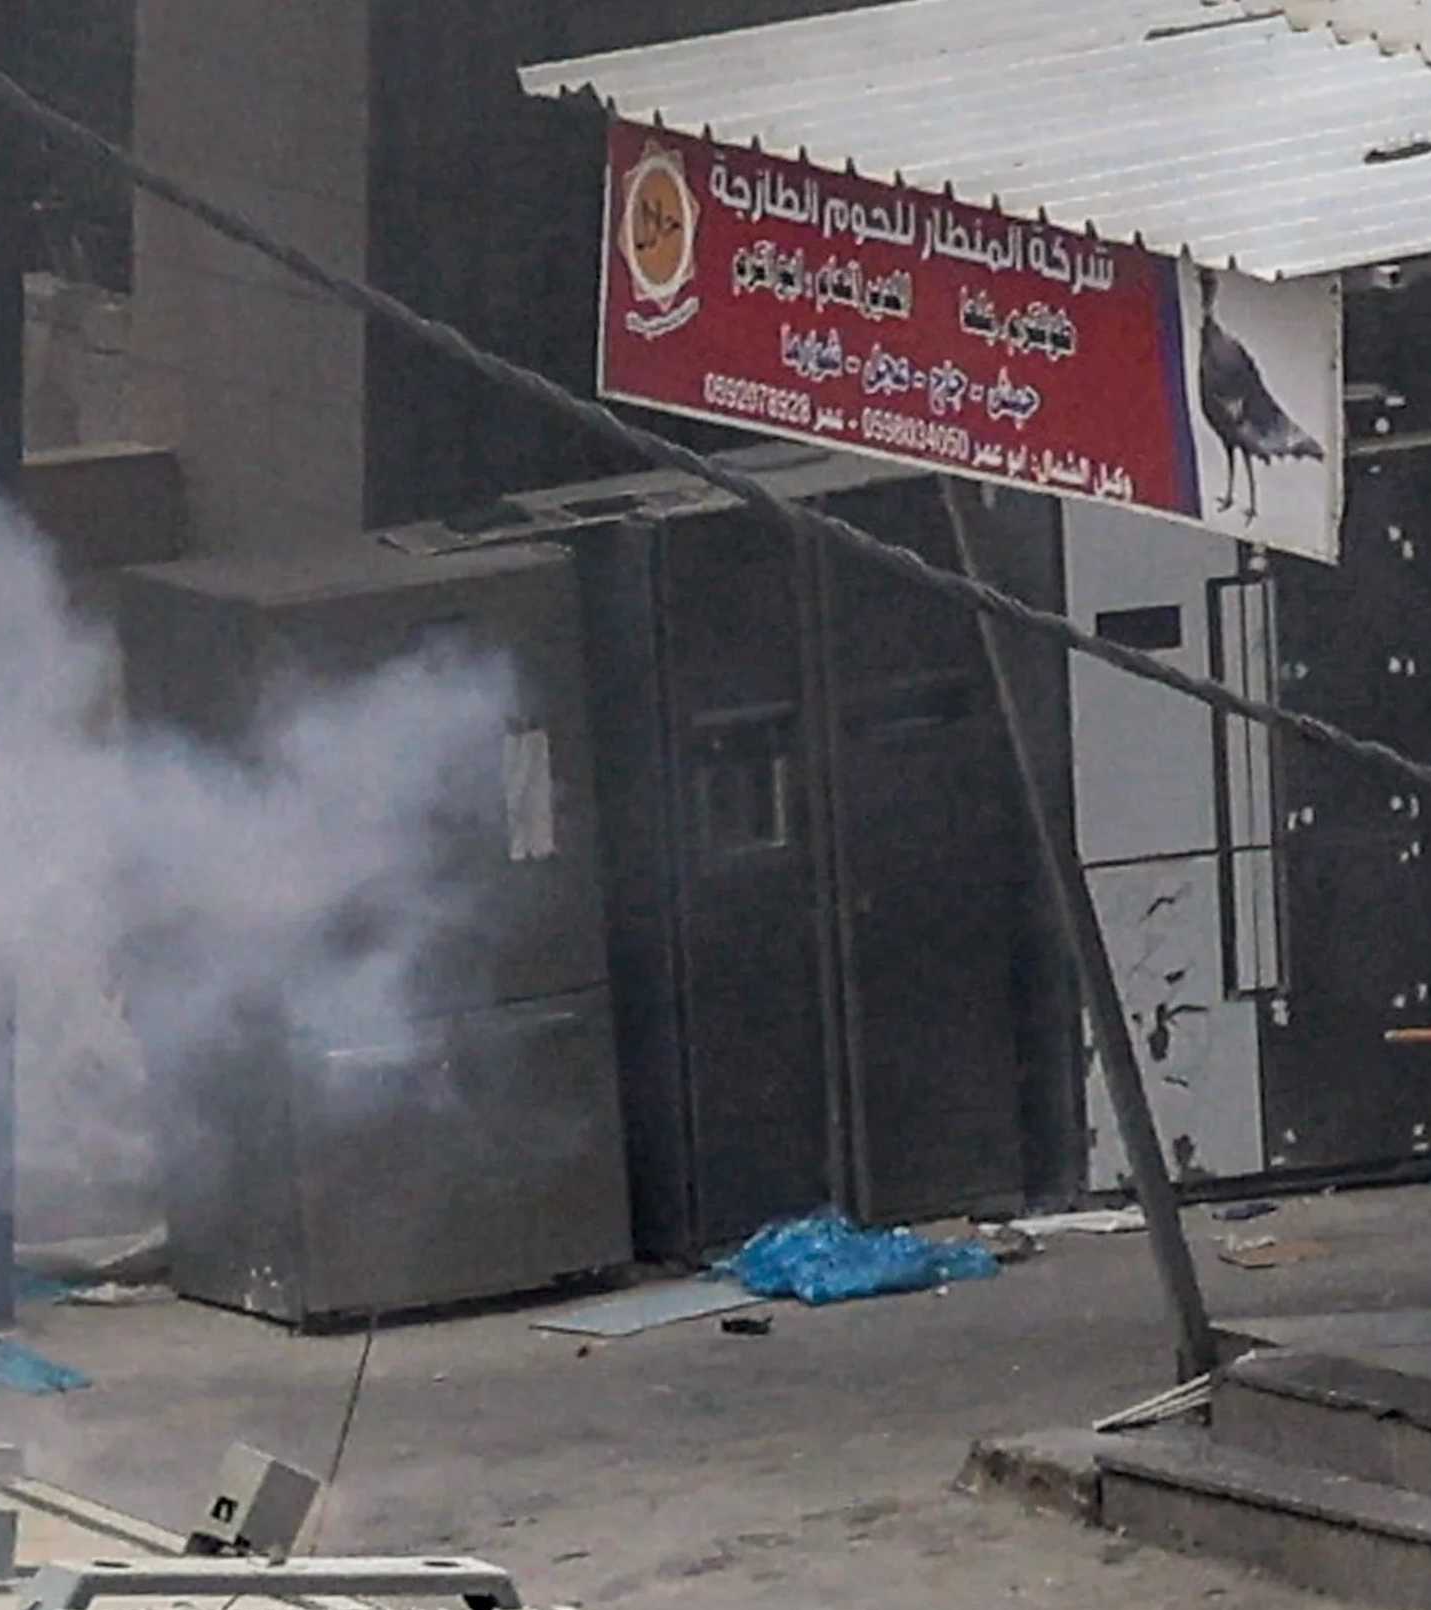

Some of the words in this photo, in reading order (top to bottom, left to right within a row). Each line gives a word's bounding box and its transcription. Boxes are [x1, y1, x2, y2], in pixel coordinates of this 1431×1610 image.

[709, 152, 819, 225] الطازجة
[823, 197, 915, 246] للحوم
[921, 208, 1023, 272] المنطار
[1028, 225, 1115, 294] شركة
